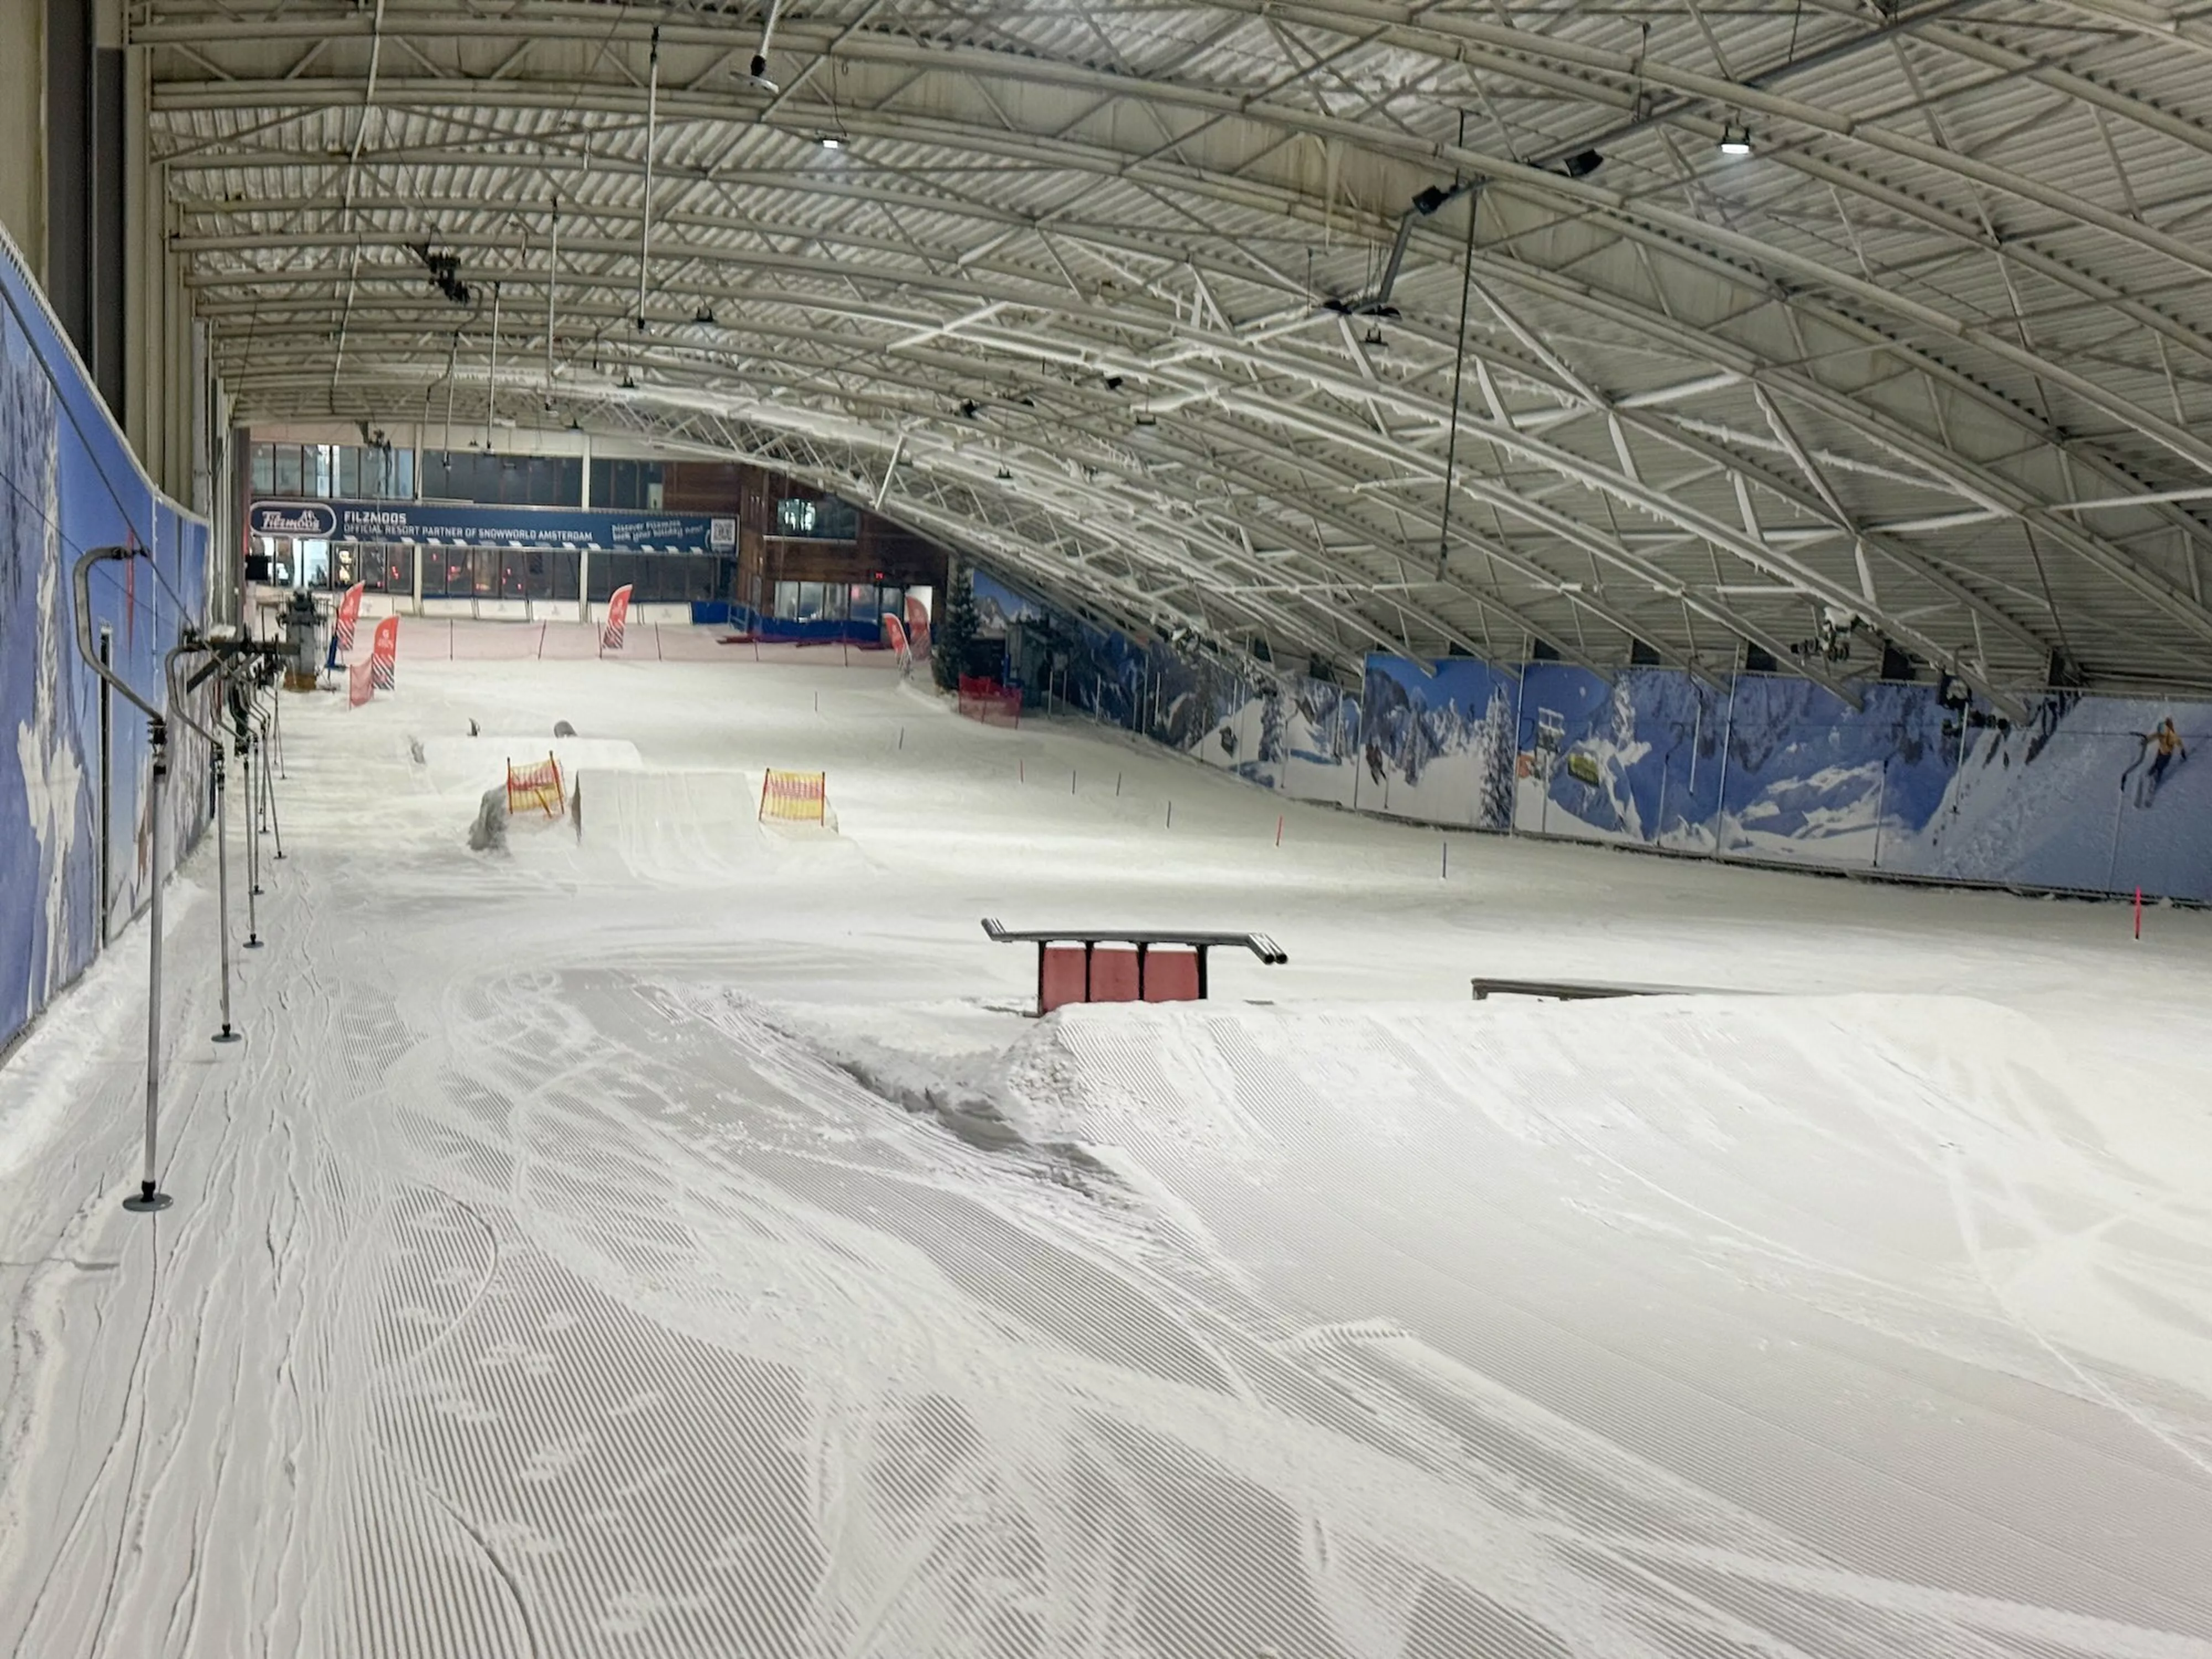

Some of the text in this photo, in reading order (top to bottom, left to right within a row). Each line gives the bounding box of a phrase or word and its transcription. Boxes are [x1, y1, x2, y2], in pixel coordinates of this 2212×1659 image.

[262, 510, 320, 532] Filzmoos
[344, 511, 406, 525] FILZMOOS
[344, 524, 593, 541] OFFICIAL RESORT PARTNER OF SNOWWORLD AMSTERDAM
